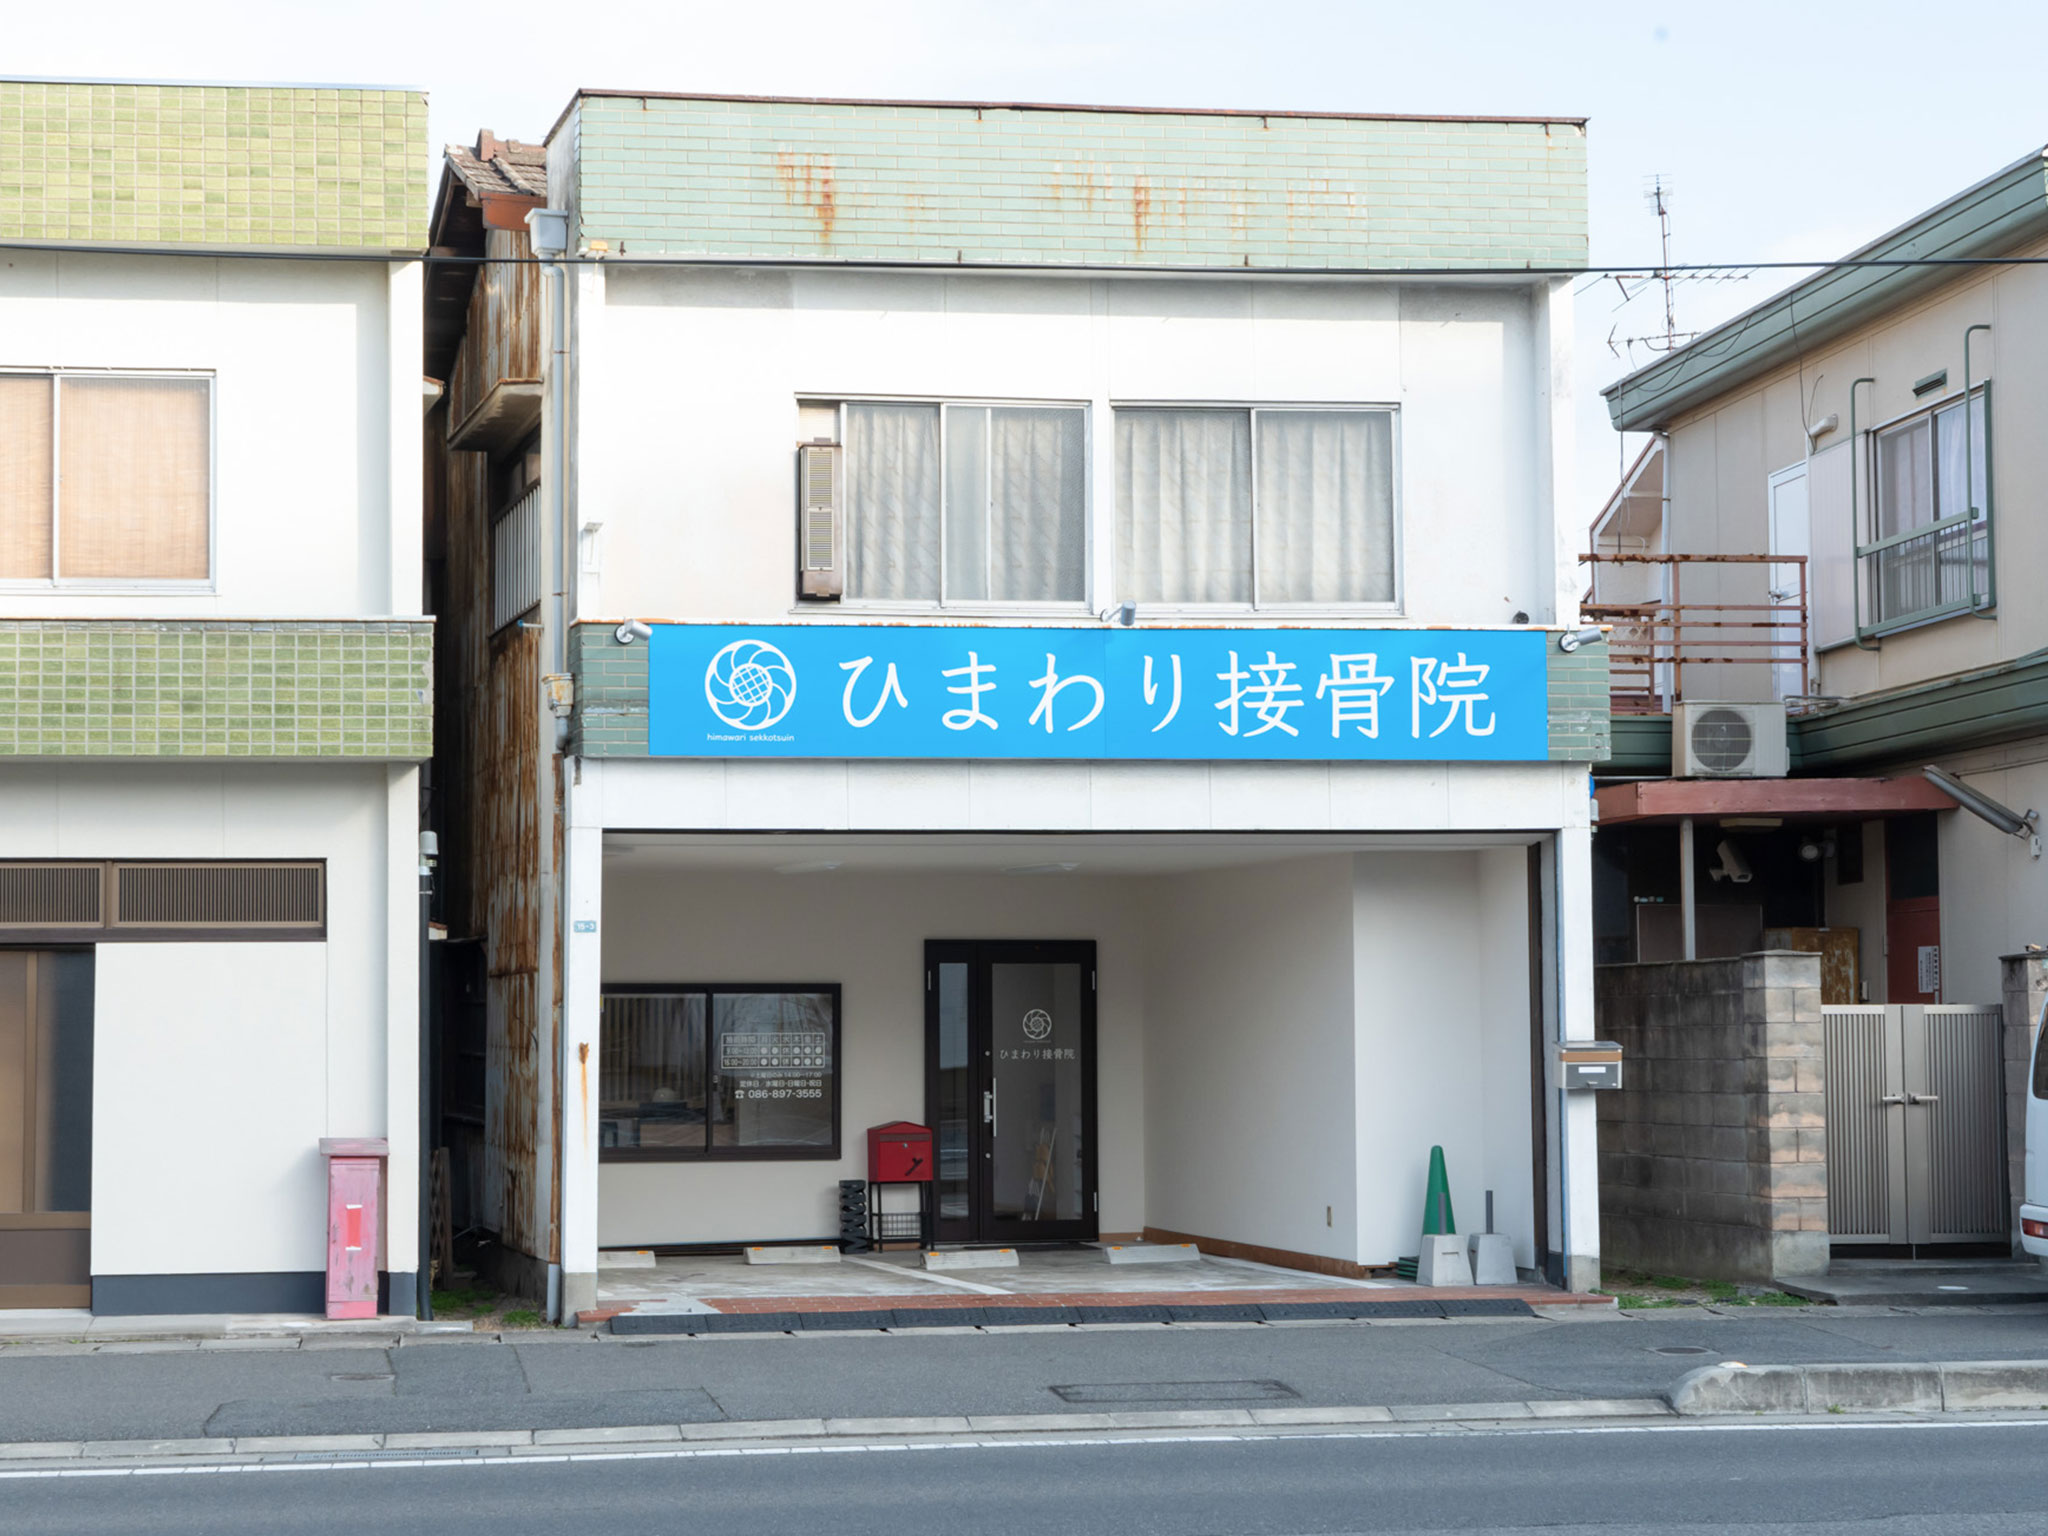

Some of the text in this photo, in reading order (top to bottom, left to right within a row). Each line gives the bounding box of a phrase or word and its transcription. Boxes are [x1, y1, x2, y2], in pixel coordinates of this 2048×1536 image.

[839, 651, 1495, 738] ひまわり接骨院
[707, 733, 795, 741] himawari sekkotsuin
[1000, 1048, 1075, 1060] ひまわり接骨院
[748, 1089, 822, 1099] 086-897-3555
